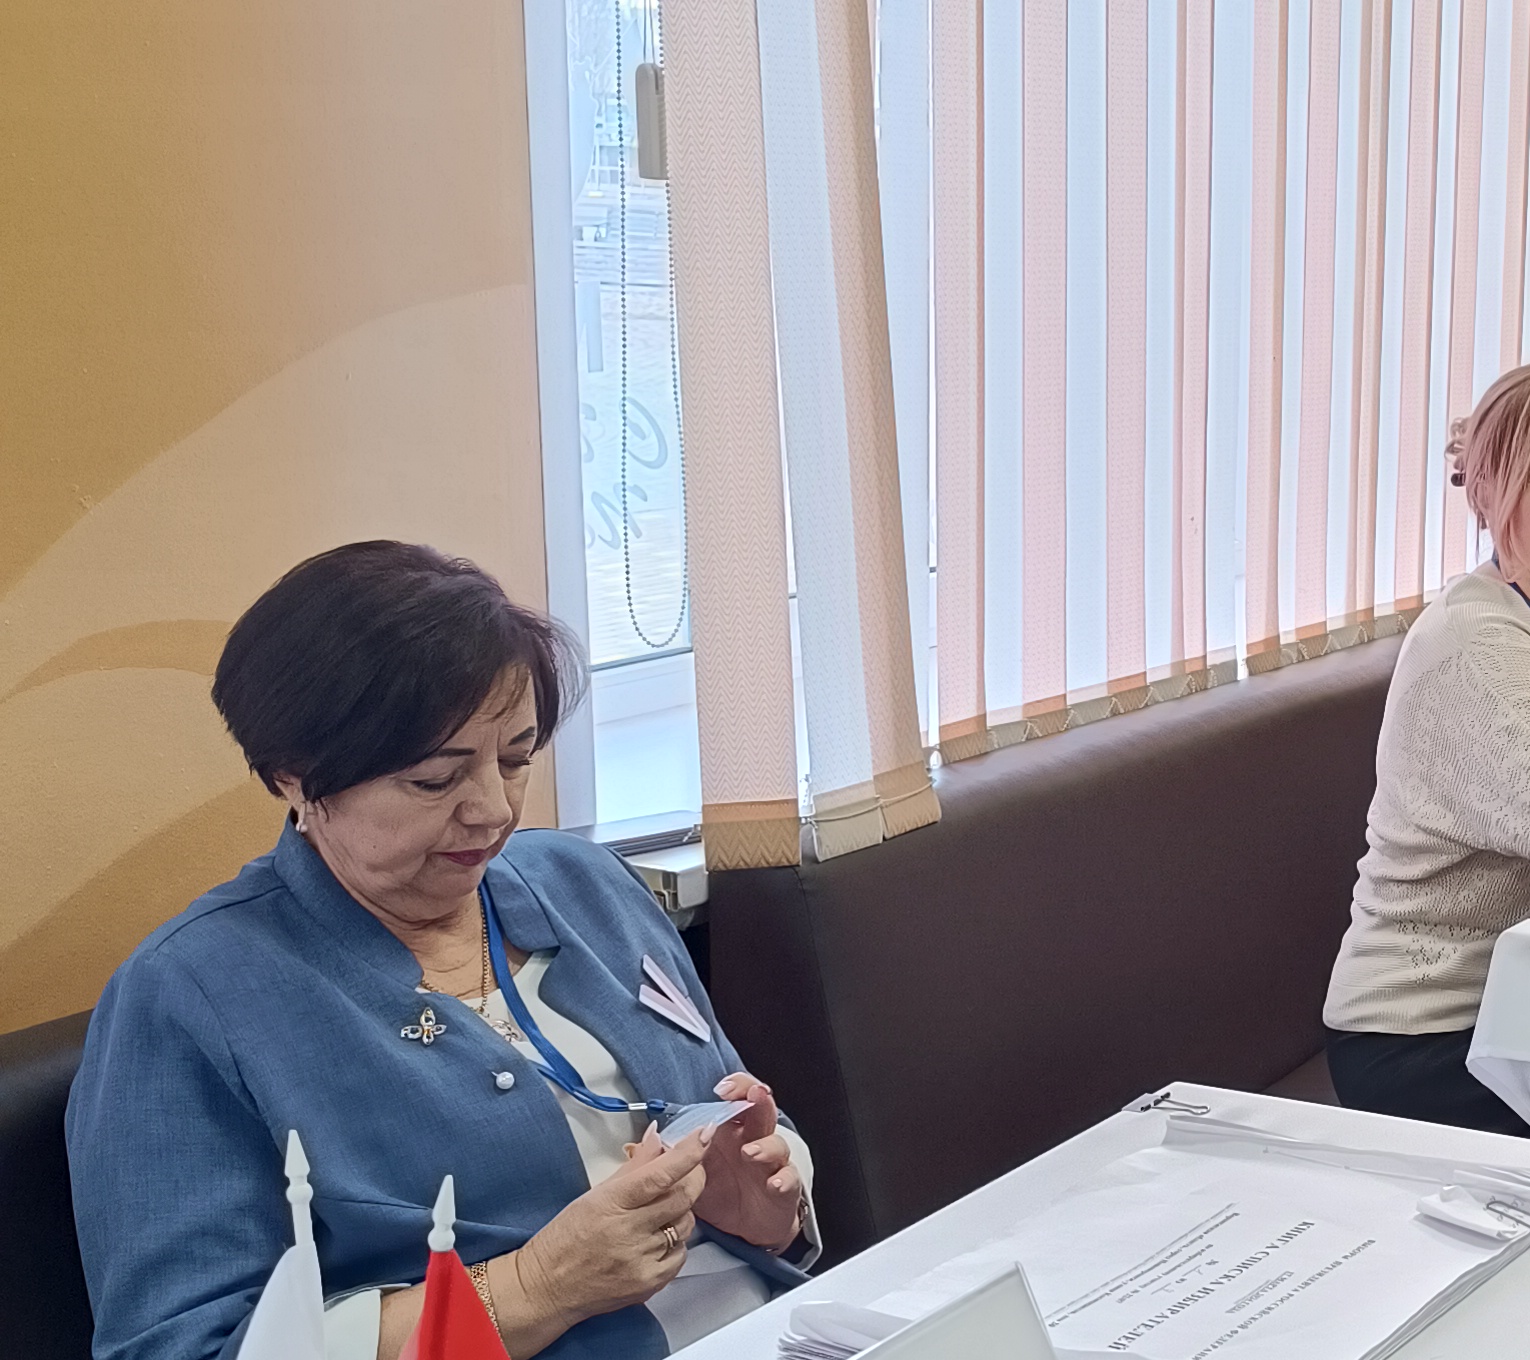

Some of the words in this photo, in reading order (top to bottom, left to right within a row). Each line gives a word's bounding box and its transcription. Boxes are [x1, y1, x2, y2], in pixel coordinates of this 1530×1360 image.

[1261, 1221, 1315, 1249] КНИГА
[1209, 1251, 1270, 1288] СПИСКА
[1106, 1284, 1217, 1353] ИЗБИРАТЕЛЕЙ
